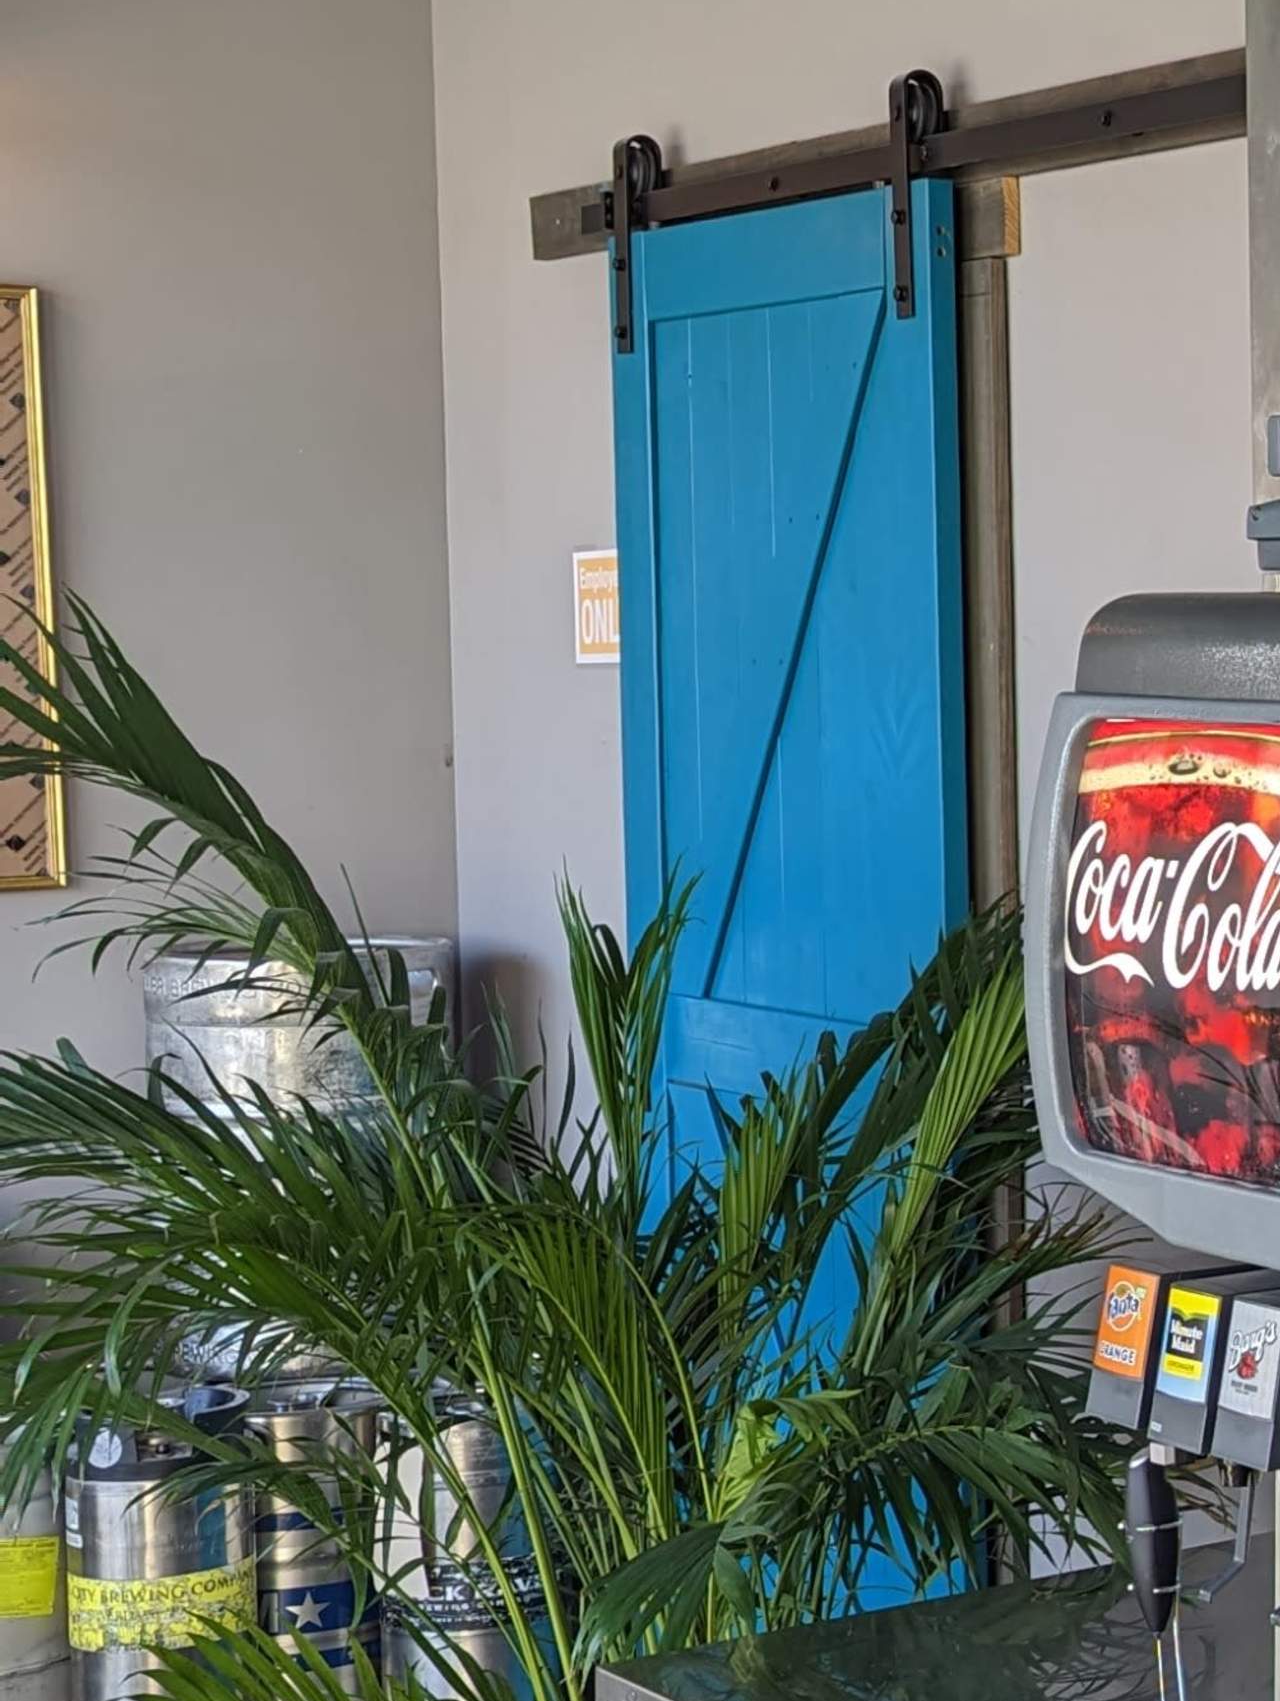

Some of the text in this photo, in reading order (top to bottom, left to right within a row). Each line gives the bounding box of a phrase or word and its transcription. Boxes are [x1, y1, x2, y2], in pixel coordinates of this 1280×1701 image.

[1169, 1319, 1204, 1340] Minute
[1169, 1334, 1196, 1354] Maid
[100, 1583, 186, 1603] BREWING
